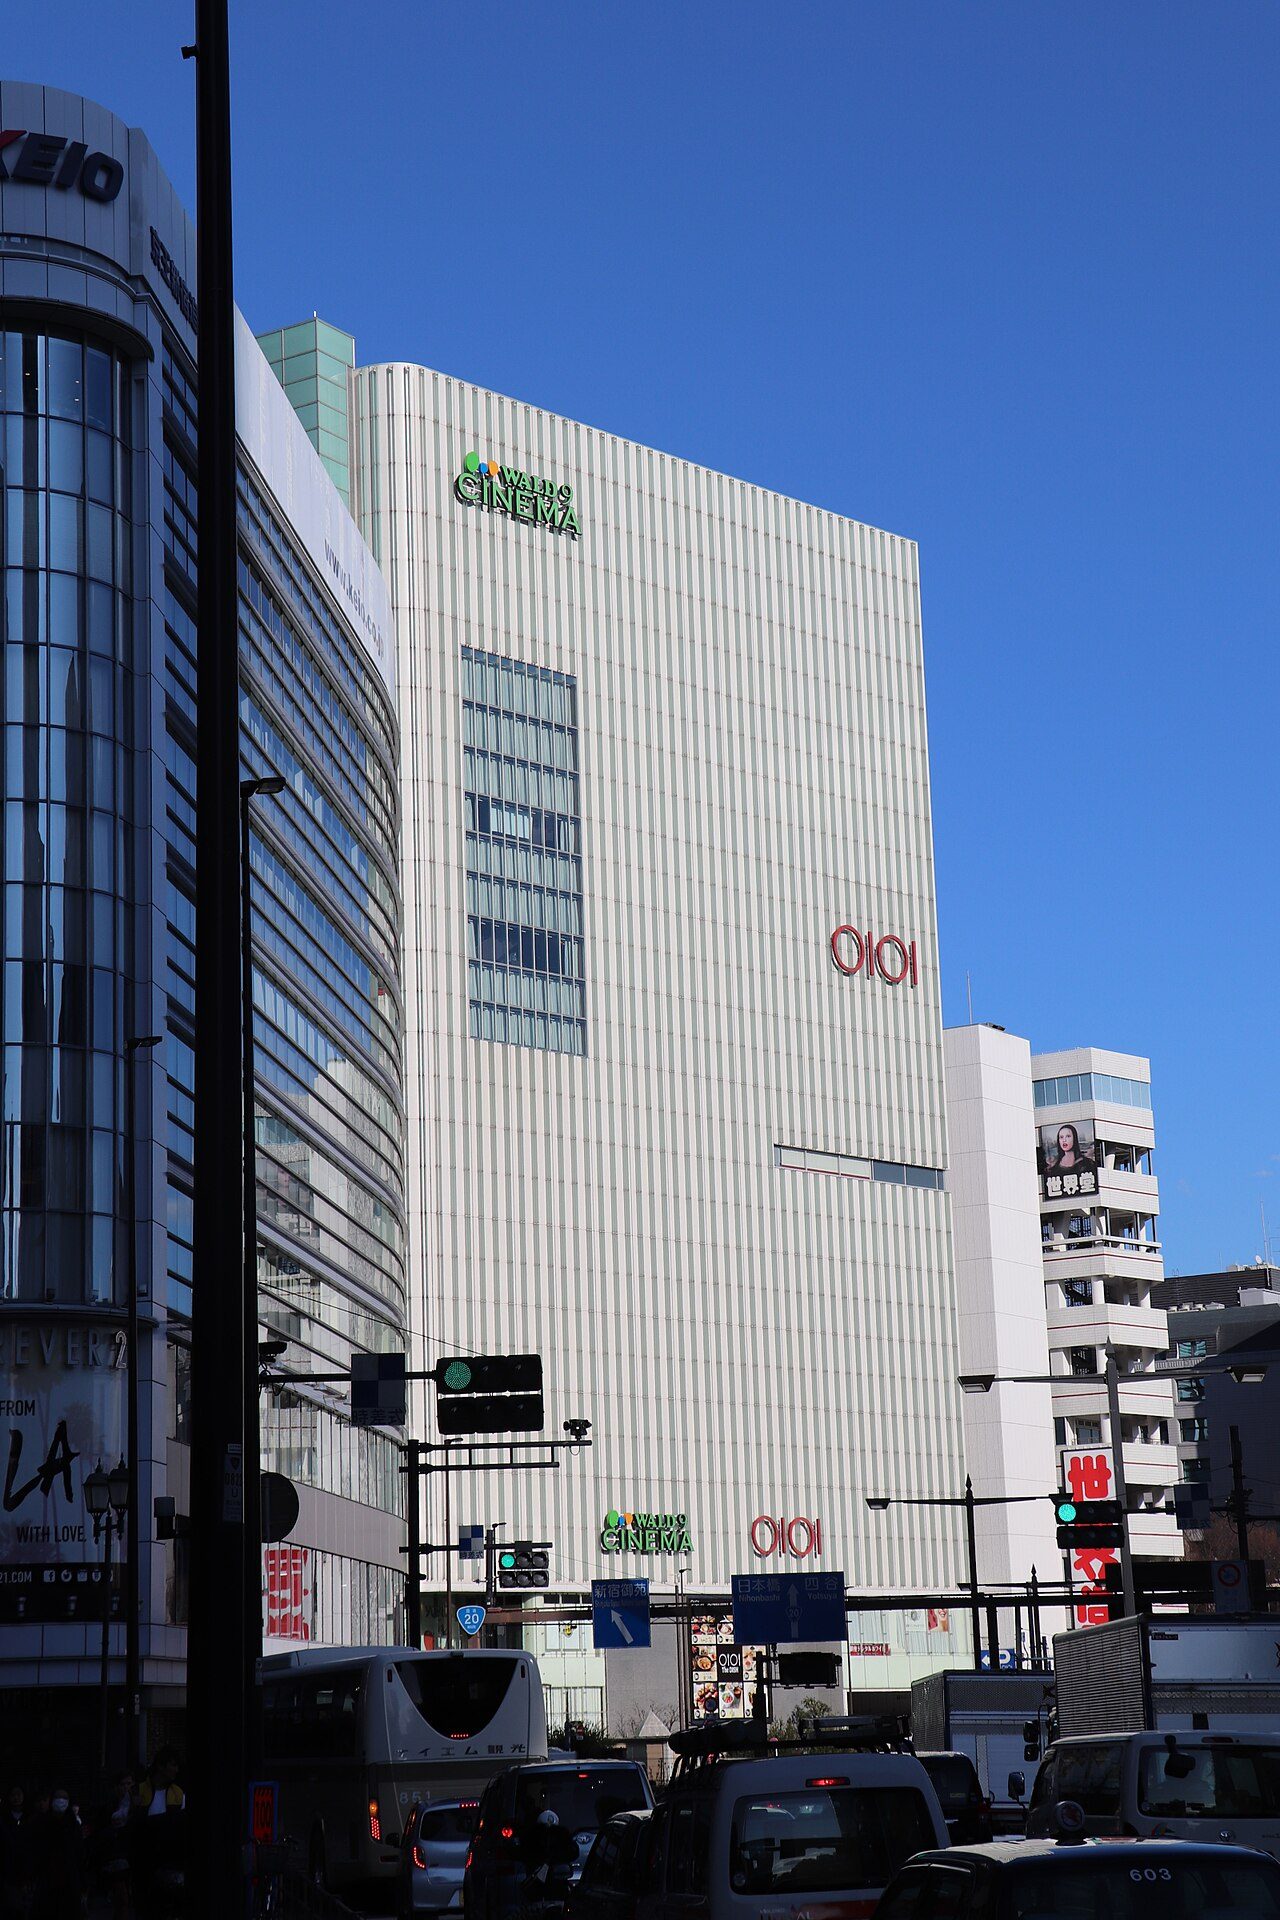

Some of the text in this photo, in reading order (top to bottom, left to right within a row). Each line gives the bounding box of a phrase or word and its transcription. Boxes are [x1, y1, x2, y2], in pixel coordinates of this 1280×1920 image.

[500, 464, 574, 506] WALD 9
[456, 472, 582, 537] CINEMA
[1046, 1172, 1096, 1197] 世界堂
[0, 1327, 104, 1367] EVER
[0, 1400, 36, 1416] FROM
[353, 1408, 403, 1425] 時差式
[4, 1420, 80, 1511] LA
[632, 1513, 688, 1529] WALD 9
[17, 1525, 50, 1543] WITH
[602, 1528, 695, 1552] CINEMA
[594, 1583, 647, 1599] 新宿御苑
[738, 1577, 780, 1593] 日本橋
[805, 1576, 838, 1591] 四谷
[738, 1593, 780, 1603] Nihonbashi
[807, 1591, 838, 1601] Yotsuya
[464, 1613, 479, 1624] 20
[789, 1608, 800, 1617] 20
[1129, 1867, 1173, 1882] 603
